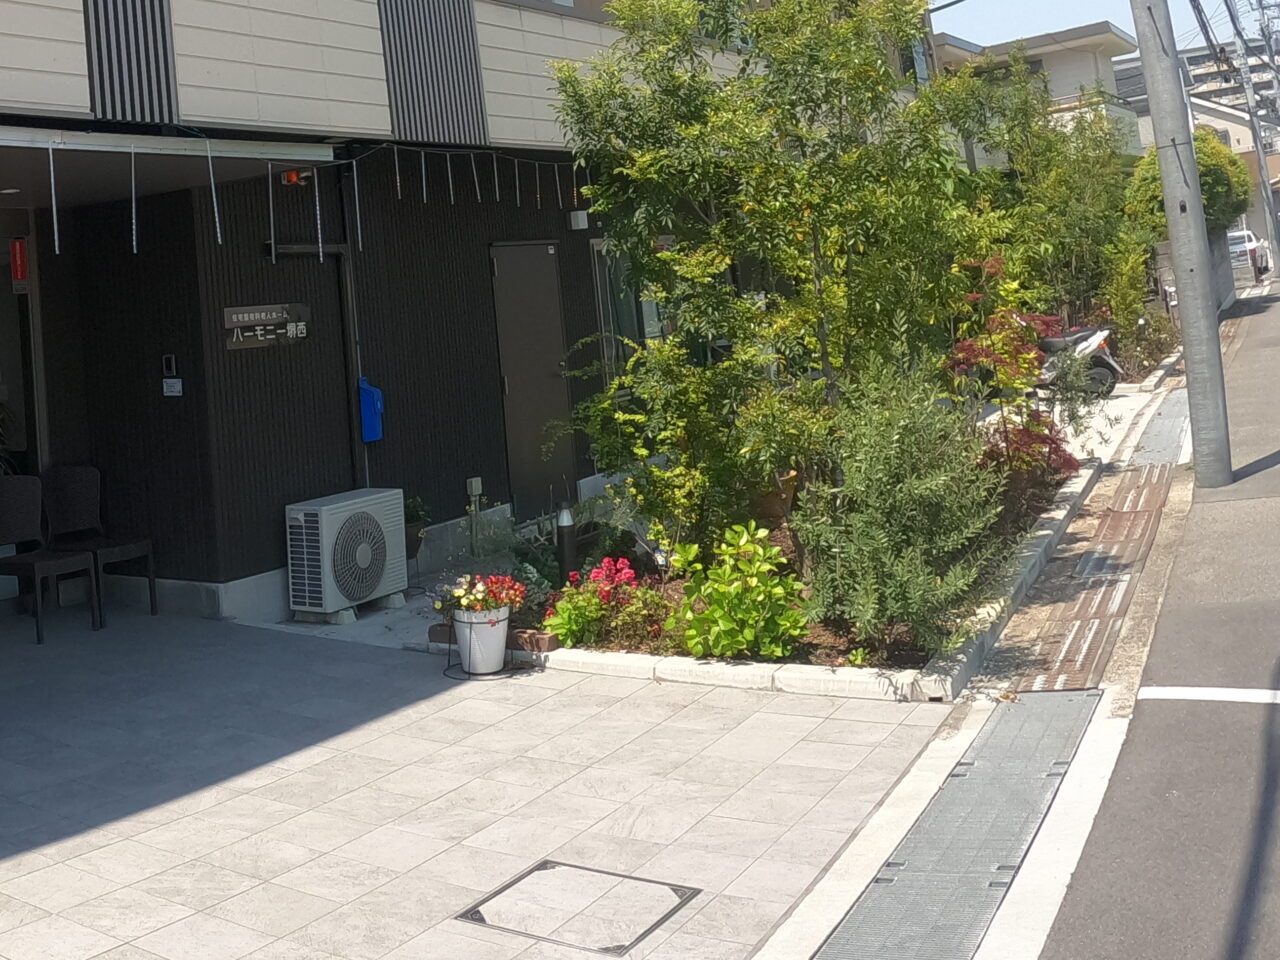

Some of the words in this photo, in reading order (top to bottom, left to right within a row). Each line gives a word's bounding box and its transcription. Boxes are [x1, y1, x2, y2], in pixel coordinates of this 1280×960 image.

[232, 321, 307, 342] ハーモニー堺西
